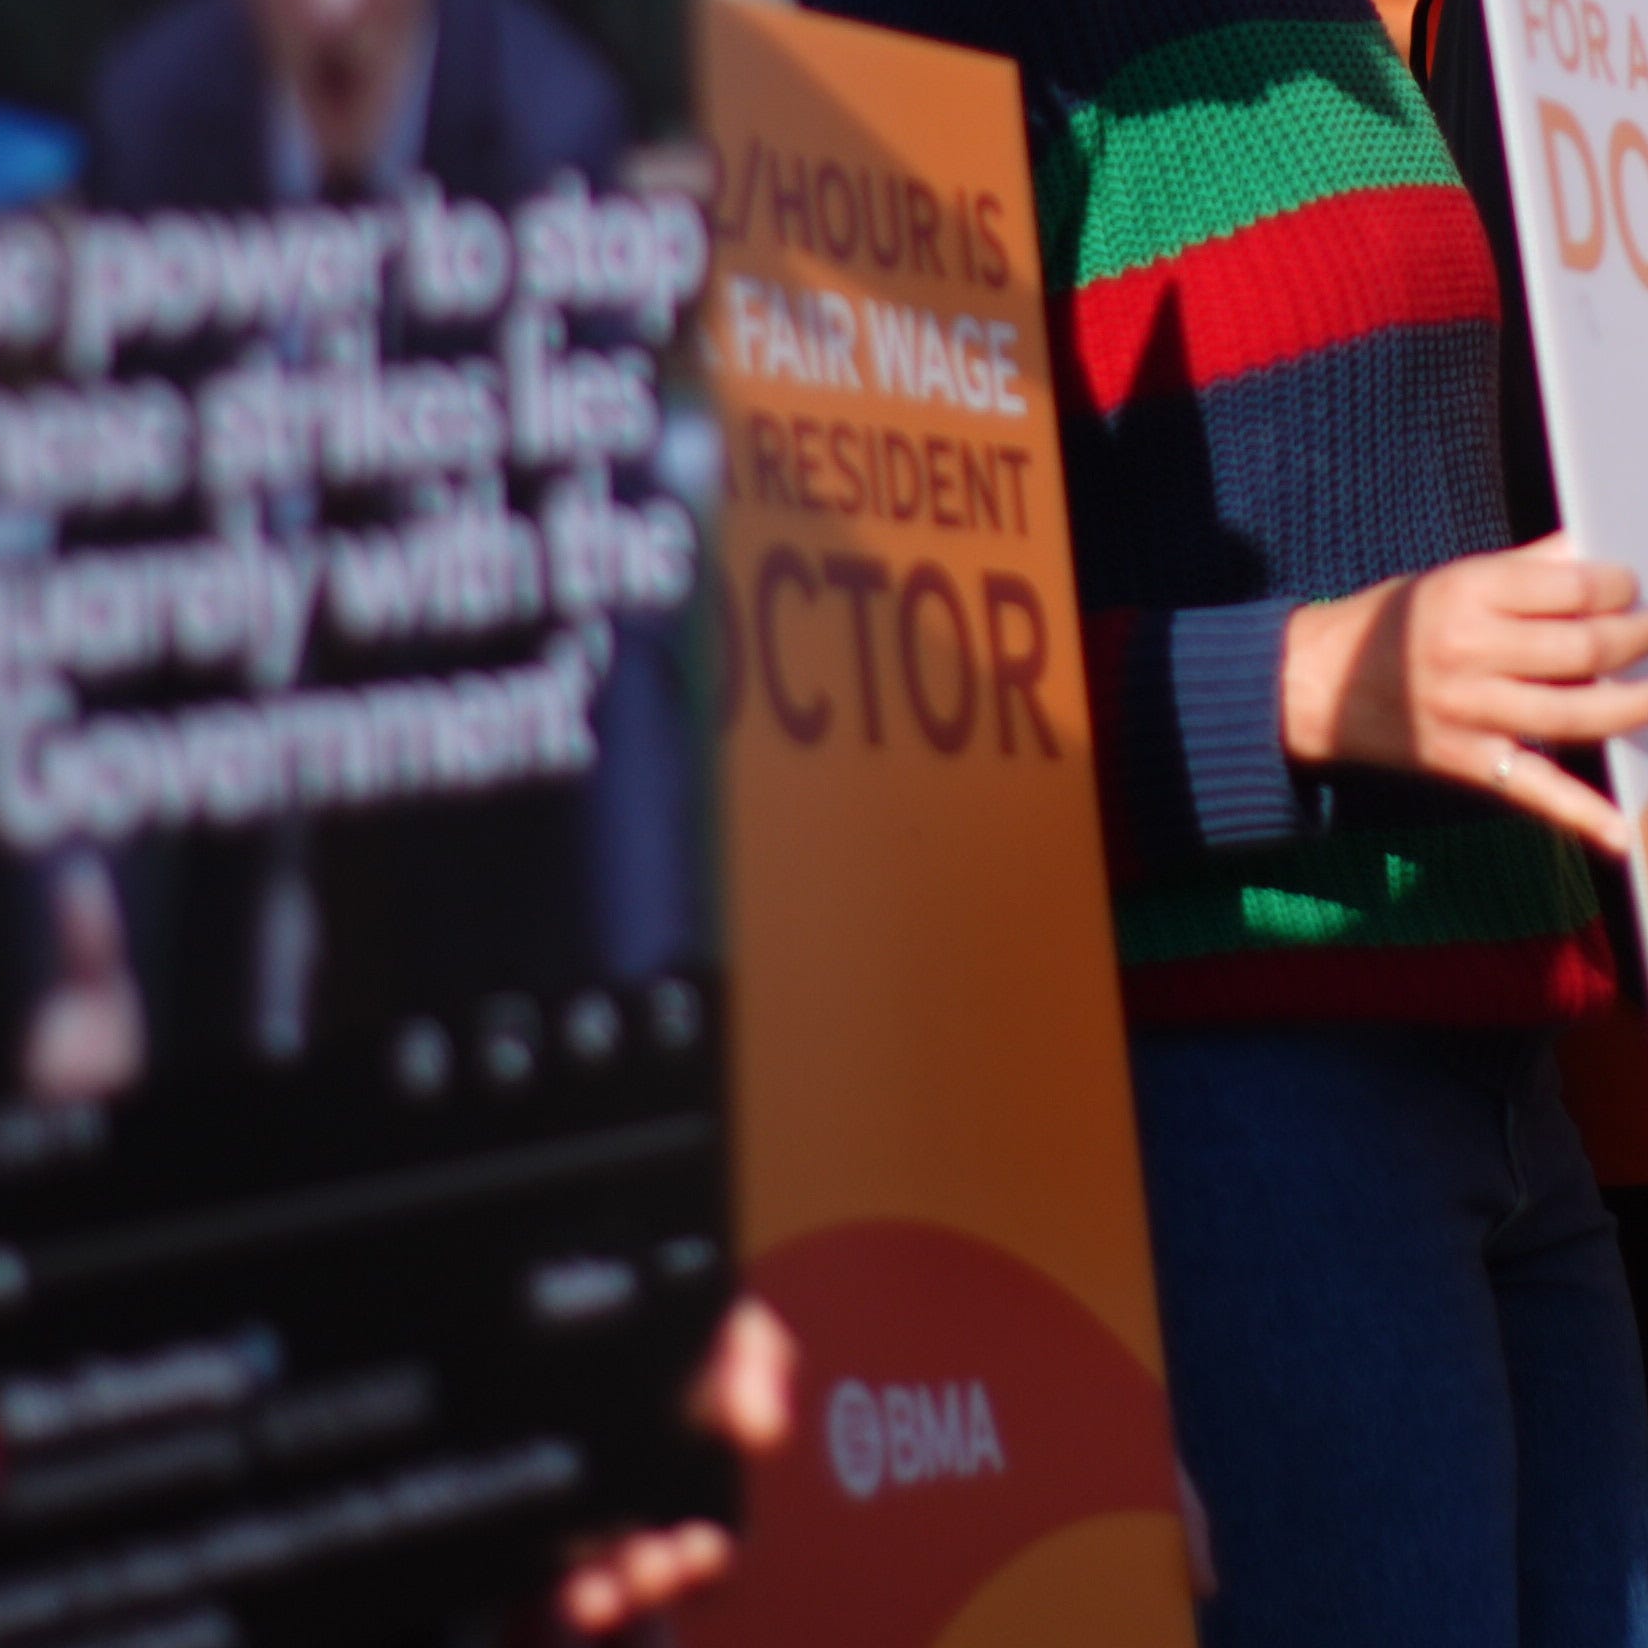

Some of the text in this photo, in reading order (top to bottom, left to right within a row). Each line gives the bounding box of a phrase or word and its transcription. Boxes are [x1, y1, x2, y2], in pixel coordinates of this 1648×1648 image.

[70, 209, 392, 380] power
[408, 176, 508, 318] to
[515, 172, 710, 340] stop
[955, 185, 1010, 290] IS
[199, 302, 504, 494] strikes
[506, 302, 655, 466] lies
[726, 273, 863, 392] FAIR
[863, 298, 1028, 414] WAGE
[747, 410, 1032, 539] RESIDENT
[326, 462, 545, 634] with
[548, 459, 697, 608] the
[884, 1379, 1006, 1484] BMA
